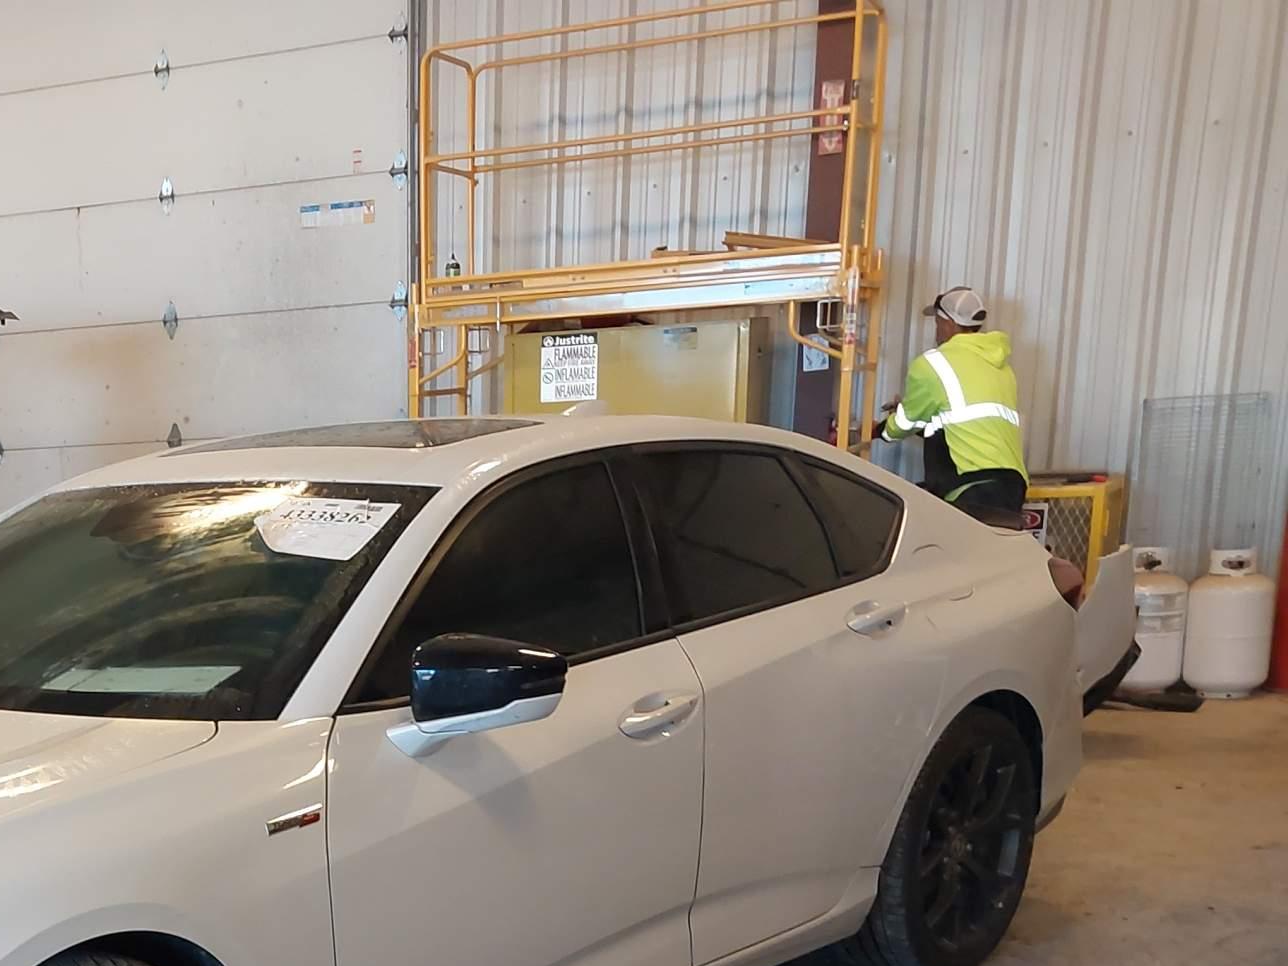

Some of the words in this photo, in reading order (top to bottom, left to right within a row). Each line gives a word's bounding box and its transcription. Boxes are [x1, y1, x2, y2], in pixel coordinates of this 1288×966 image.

[554, 334, 595, 346] Justrite
[554, 346, 596, 361] FLAMMABLE
[555, 367, 595, 381] INFLAMABLE
[555, 383, 595, 397] INFLAMMABLE
[279, 509, 371, 524] 43338262
